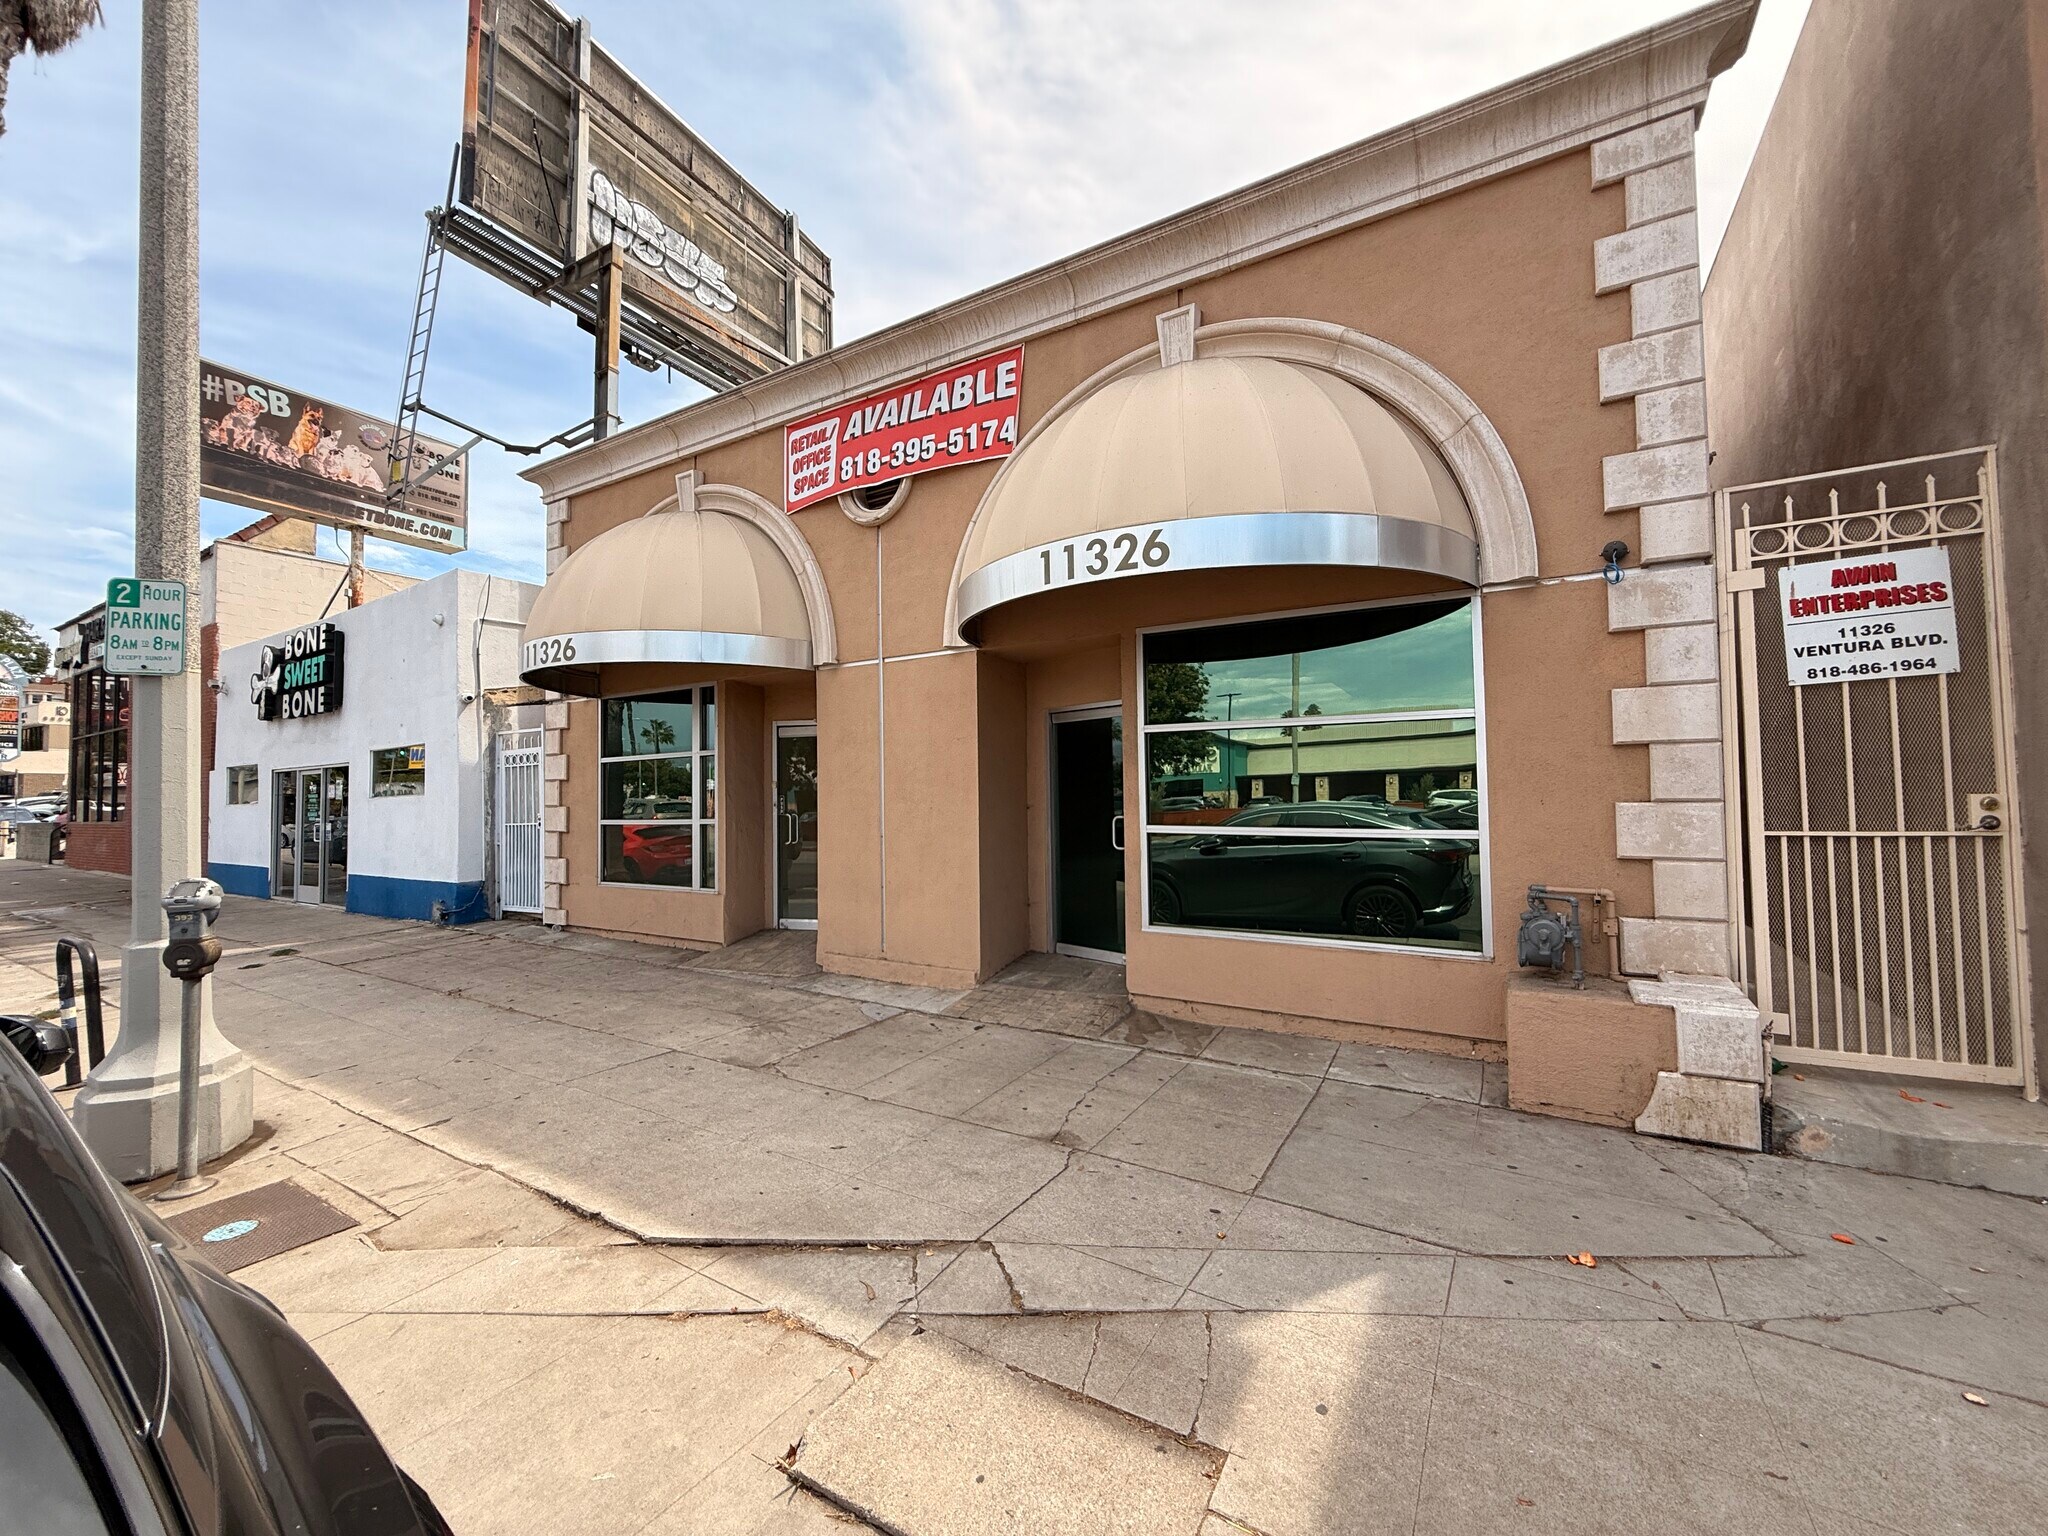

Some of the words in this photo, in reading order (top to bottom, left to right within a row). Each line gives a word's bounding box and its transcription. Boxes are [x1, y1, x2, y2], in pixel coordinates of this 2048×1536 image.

[842, 359, 1017, 443] AVAILABLE
[790, 423, 838, 457] RETAIL/
[840, 415, 1015, 482] 818-395-5174
[792, 444, 832, 475] OFFICE
[793, 469, 830, 496] SPACE
[416, 508, 427, 516] PET
[1040, 528, 1170, 586] 11326
[1831, 562, 1897, 588] AWIN
[116, 583, 131, 604] 2
[142, 588, 181, 601] HOUR
[1789, 581, 1948, 618] ENTERPRISES
[110, 611, 181, 631] PARKING
[1838, 622, 1896, 639] 11326
[110, 634, 138, 650] 8AM
[152, 636, 180, 651] 8PM
[284, 623, 327, 660] BONE
[526, 637, 576, 668] 11326
[1793, 639, 1884, 658] VENTURA
[1891, 633, 1948, 649] BLVD.
[283, 654, 326, 690] SWEET
[1806, 657, 1937, 679] 818-486-1964
[282, 685, 325, 719] BONE
